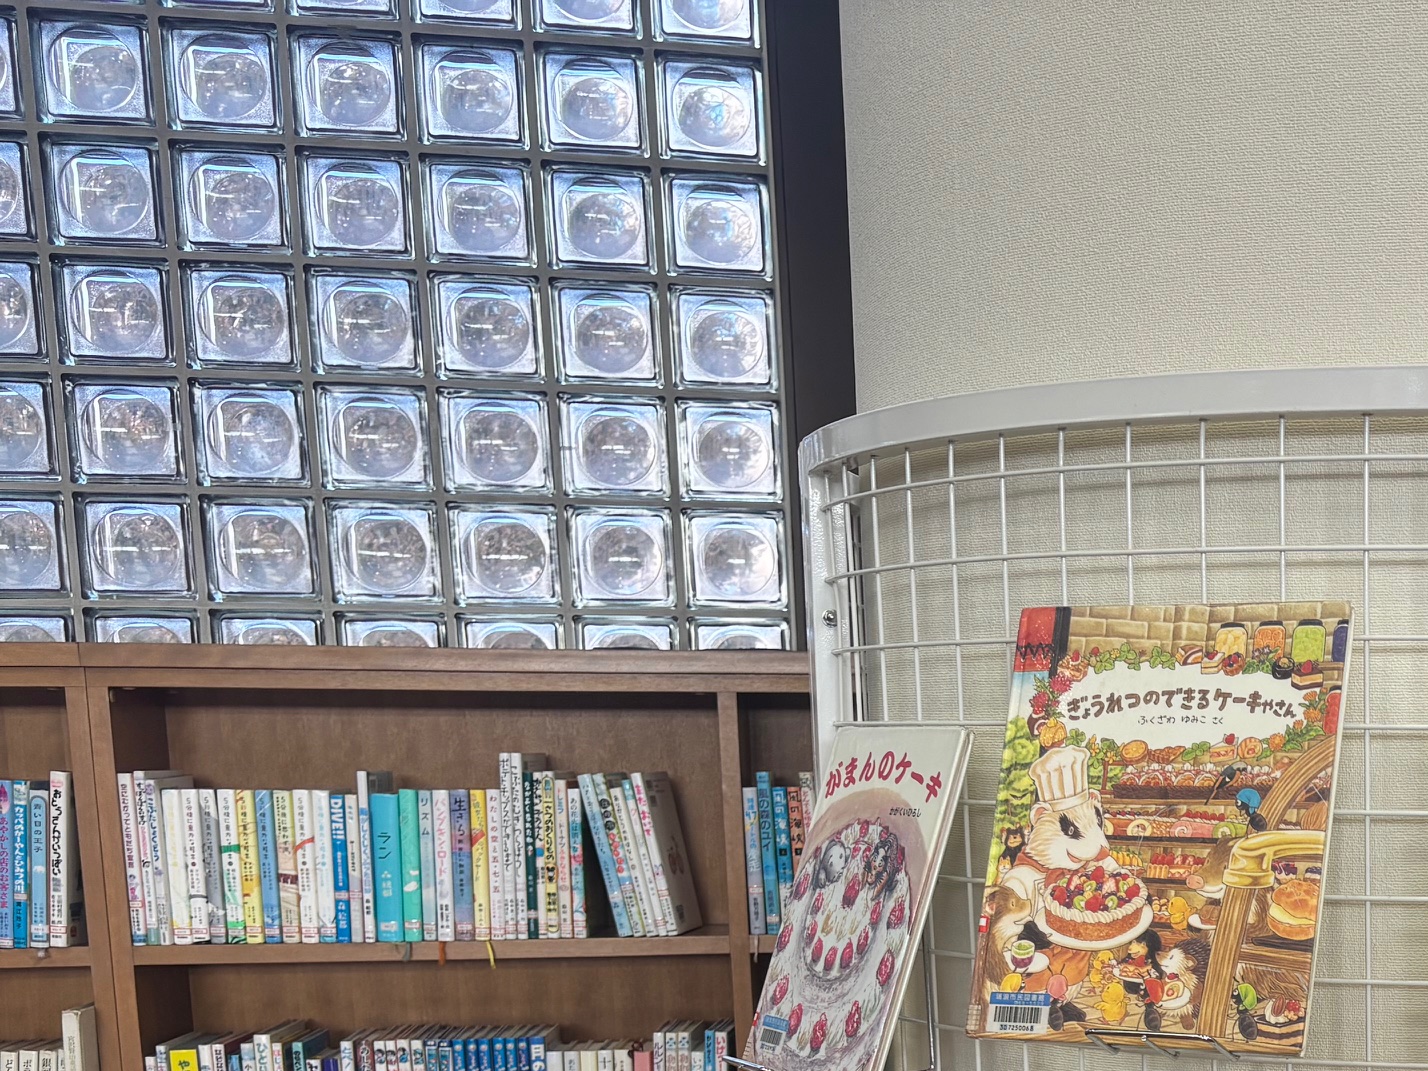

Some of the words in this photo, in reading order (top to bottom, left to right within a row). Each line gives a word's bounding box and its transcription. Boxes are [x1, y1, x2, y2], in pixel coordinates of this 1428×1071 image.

[1067, 687, 1298, 721] ぎょうれつのできるケーキやさん
[1137, 715, 1176, 725] ふくざわ
[1181, 715, 1207, 724] ゆみこ
[1212, 715, 1224, 725] さく
[824, 750, 943, 803] がまんのケーキ
[421, 798, 430, 836] リズム
[759, 788, 772, 852] 風の森のユイ
[888, 806, 923, 819] かがくいひろし
[378, 832, 392, 859] ラン
